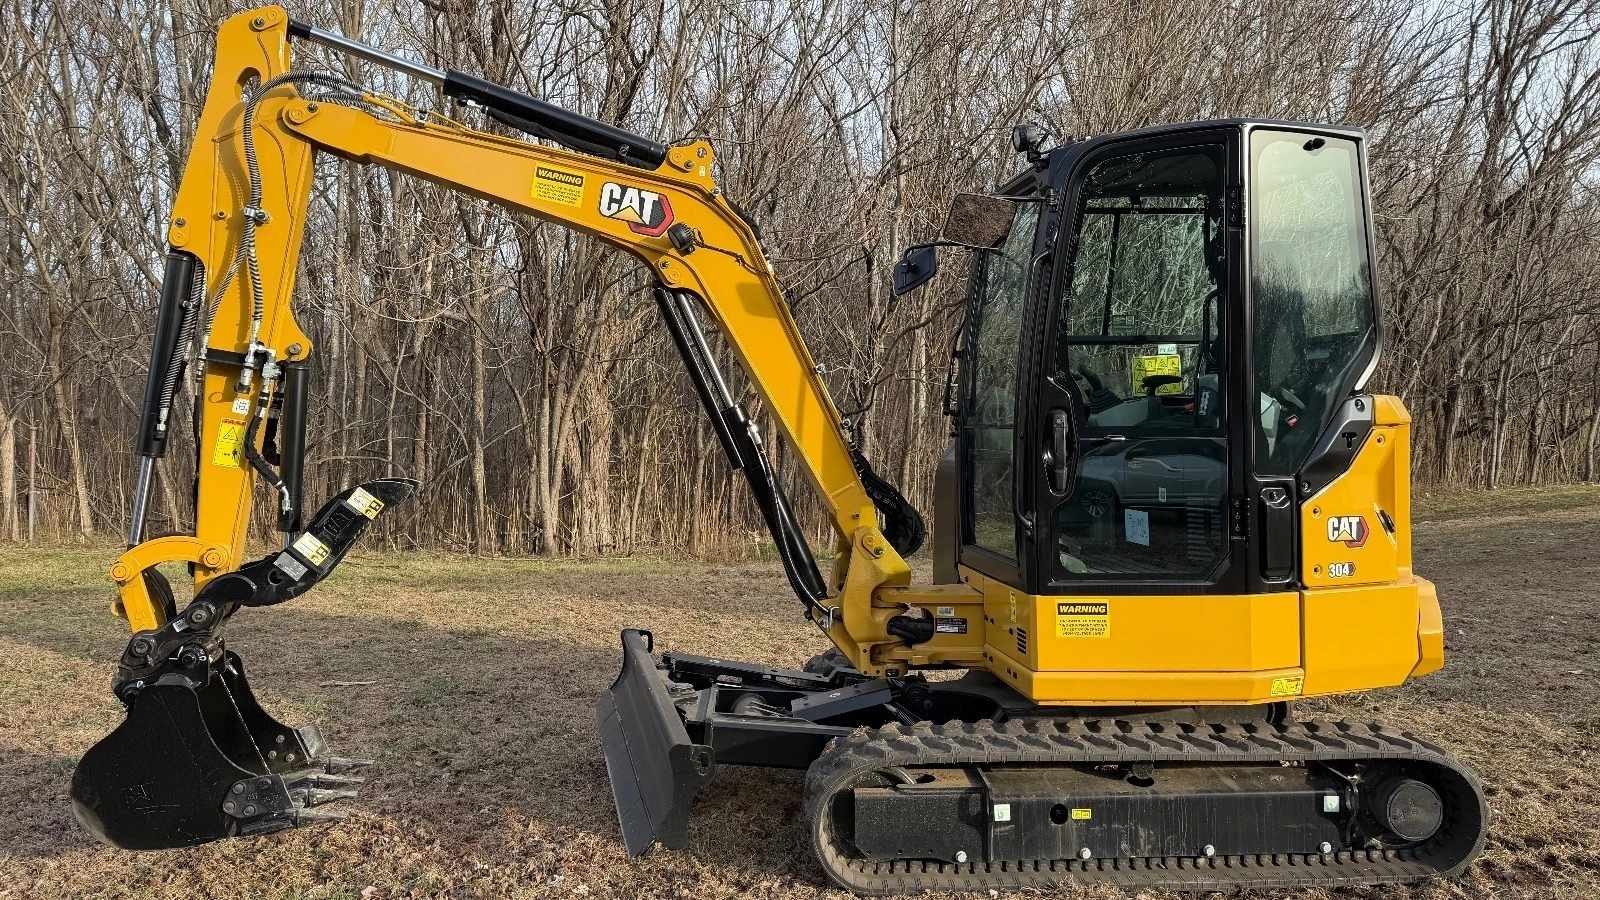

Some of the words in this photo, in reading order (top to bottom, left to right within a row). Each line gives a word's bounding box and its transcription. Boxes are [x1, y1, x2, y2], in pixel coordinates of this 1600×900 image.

[538, 169, 582, 185] WARNING
[600, 182, 660, 226] CAT
[1327, 516, 1360, 542] CAT
[1328, 563, 1350, 578] 304
[1059, 605, 1106, 613] WARNING
